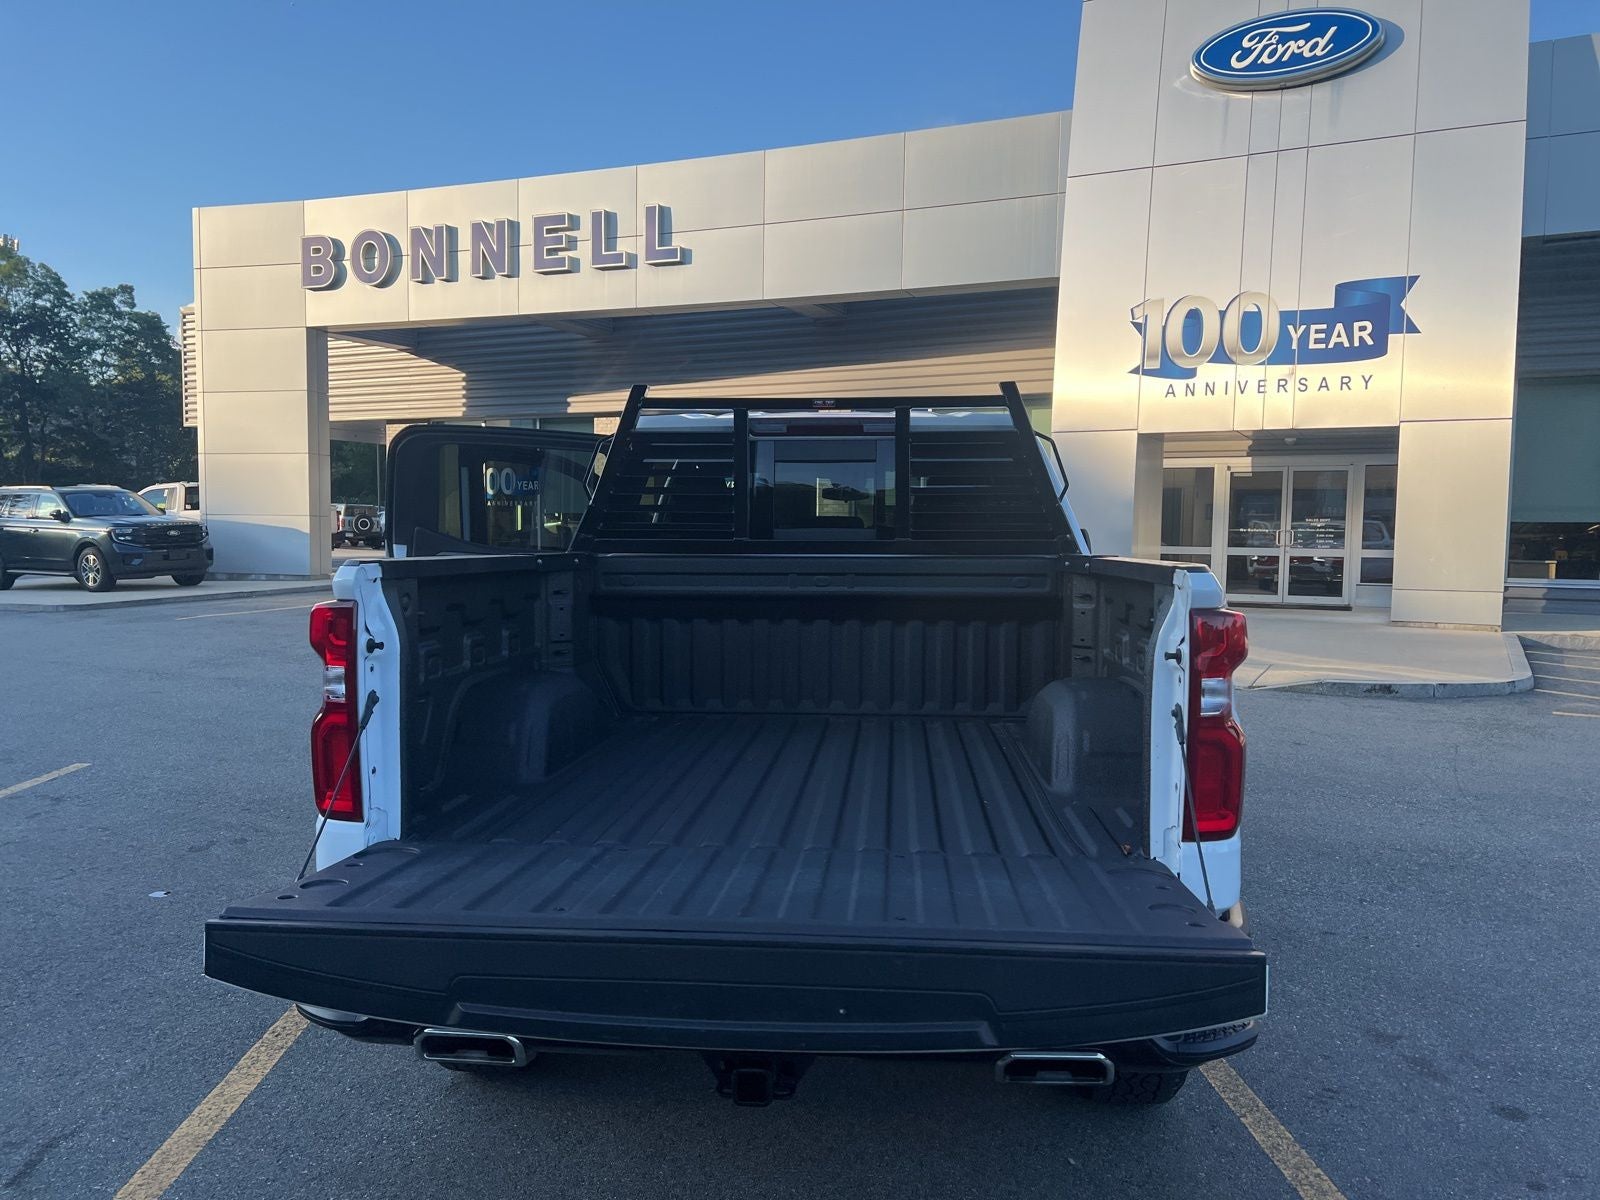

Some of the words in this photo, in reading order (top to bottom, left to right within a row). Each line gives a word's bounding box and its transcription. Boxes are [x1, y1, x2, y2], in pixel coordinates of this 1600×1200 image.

[1230, 22, 1337, 69] Ford
[301, 203, 686, 291] BONNELL
[1130, 290, 1281, 370] 100
[1286, 320, 1374, 350] YEAR
[1164, 374, 1374, 398] ANNIVERSARY
